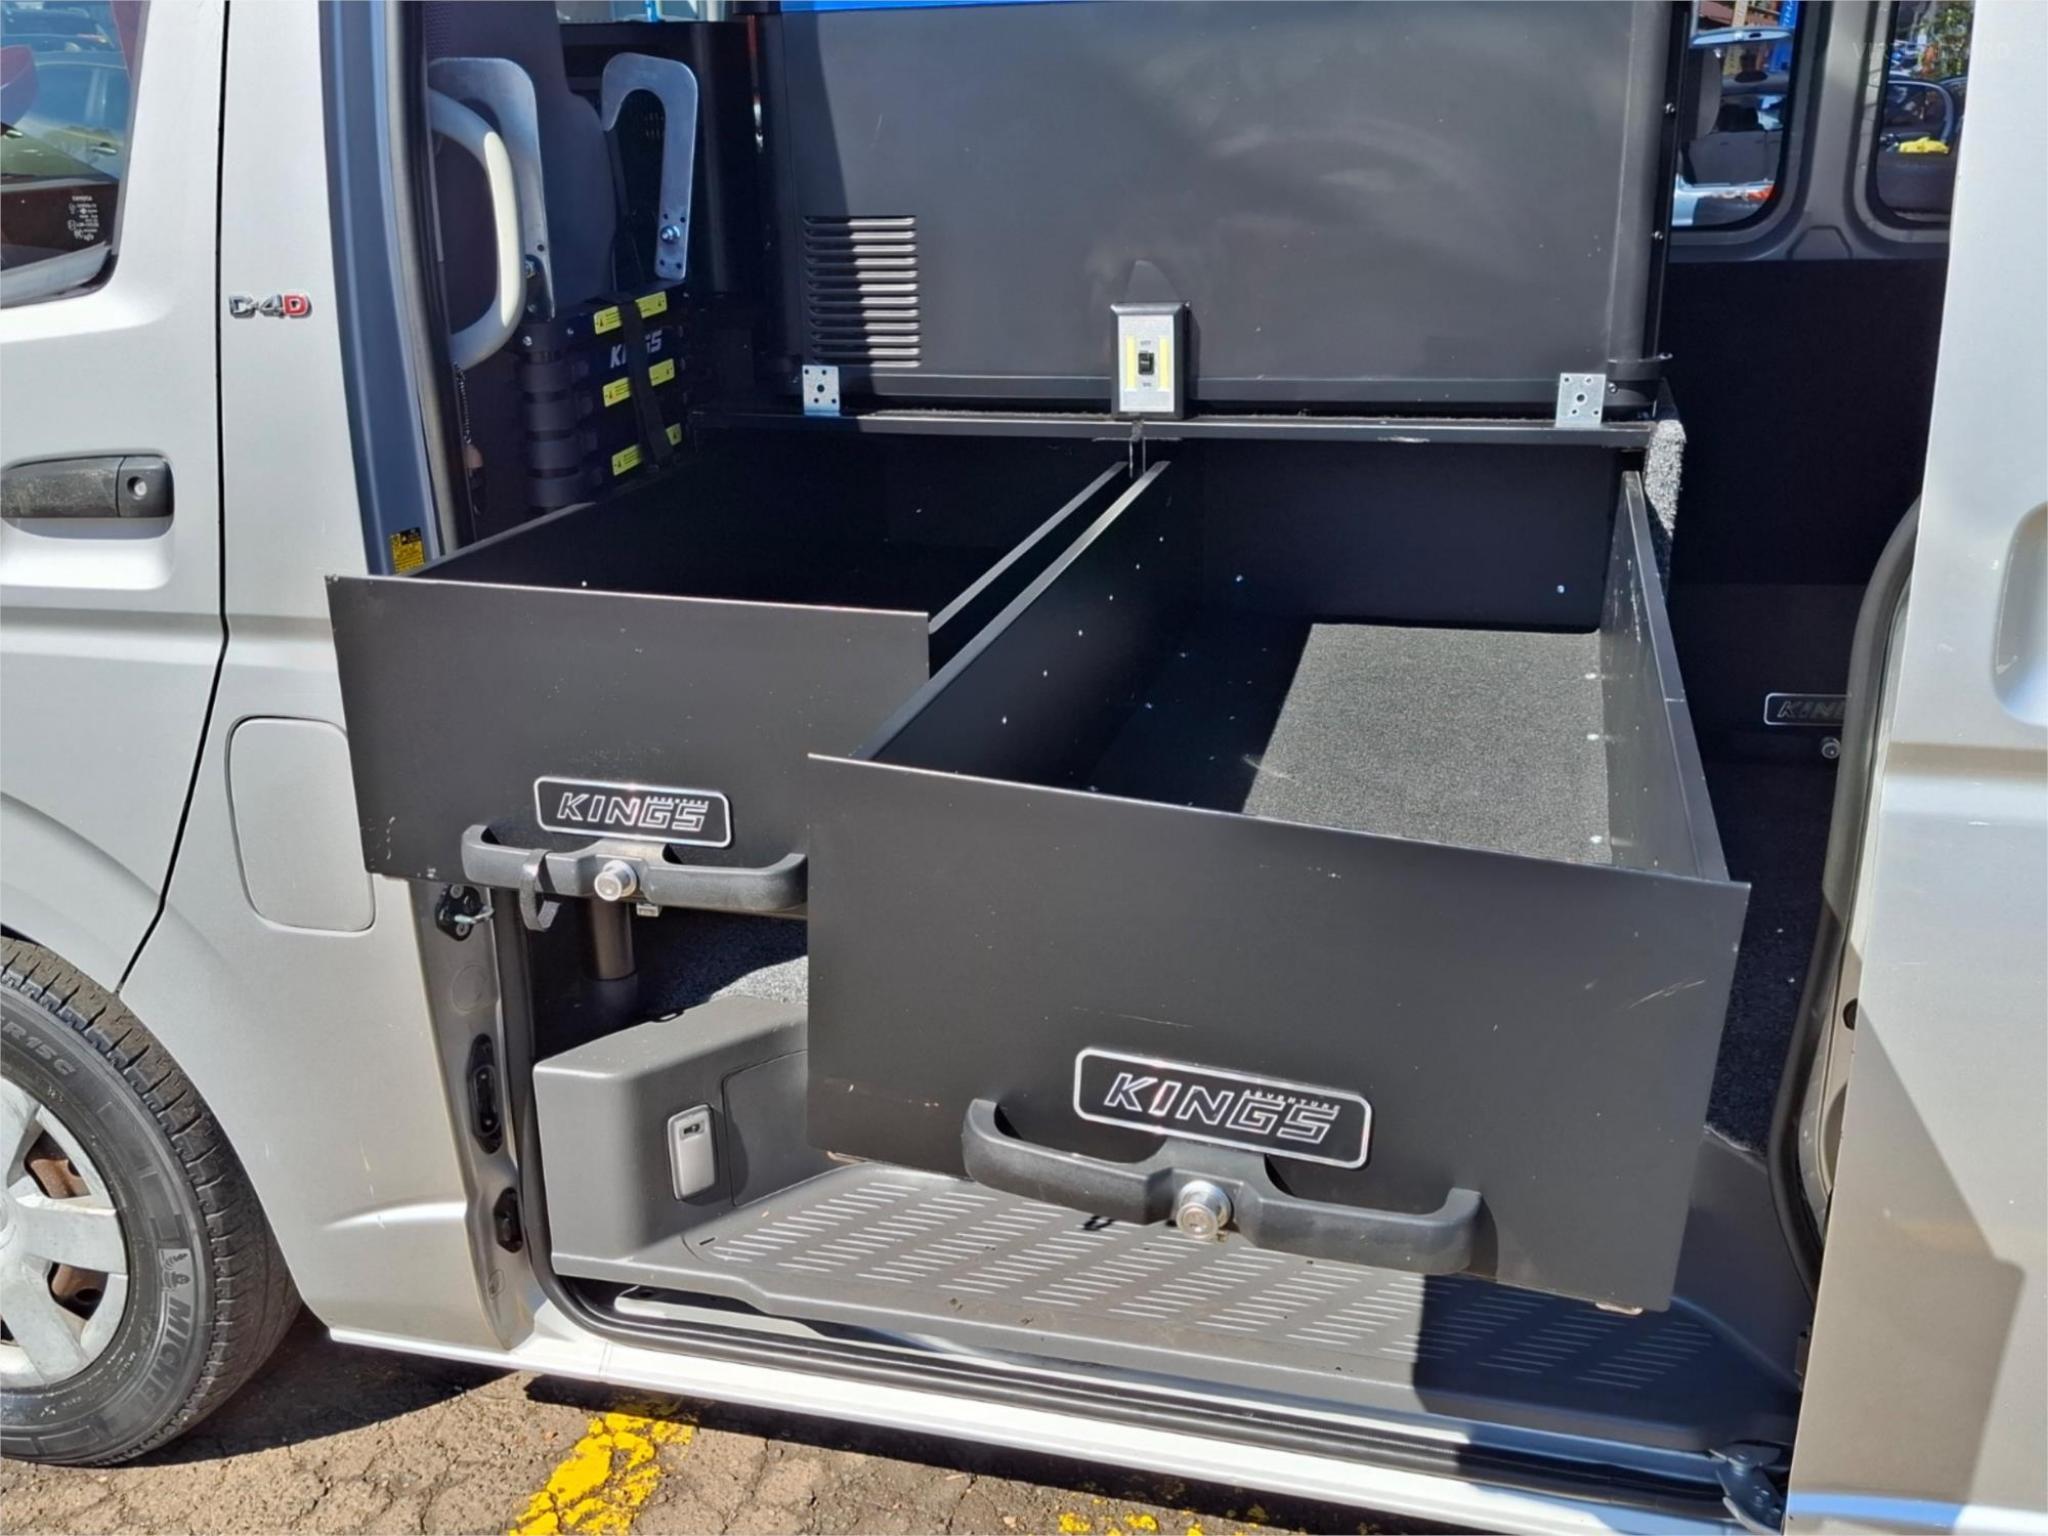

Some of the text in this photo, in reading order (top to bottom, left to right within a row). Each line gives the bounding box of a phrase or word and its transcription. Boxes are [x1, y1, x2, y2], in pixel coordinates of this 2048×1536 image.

[610, 329, 662, 369] KIS
[1776, 700, 1847, 719] KIN
[556, 792, 709, 833] KINGS
[1104, 1072, 1340, 1145] KINGS
